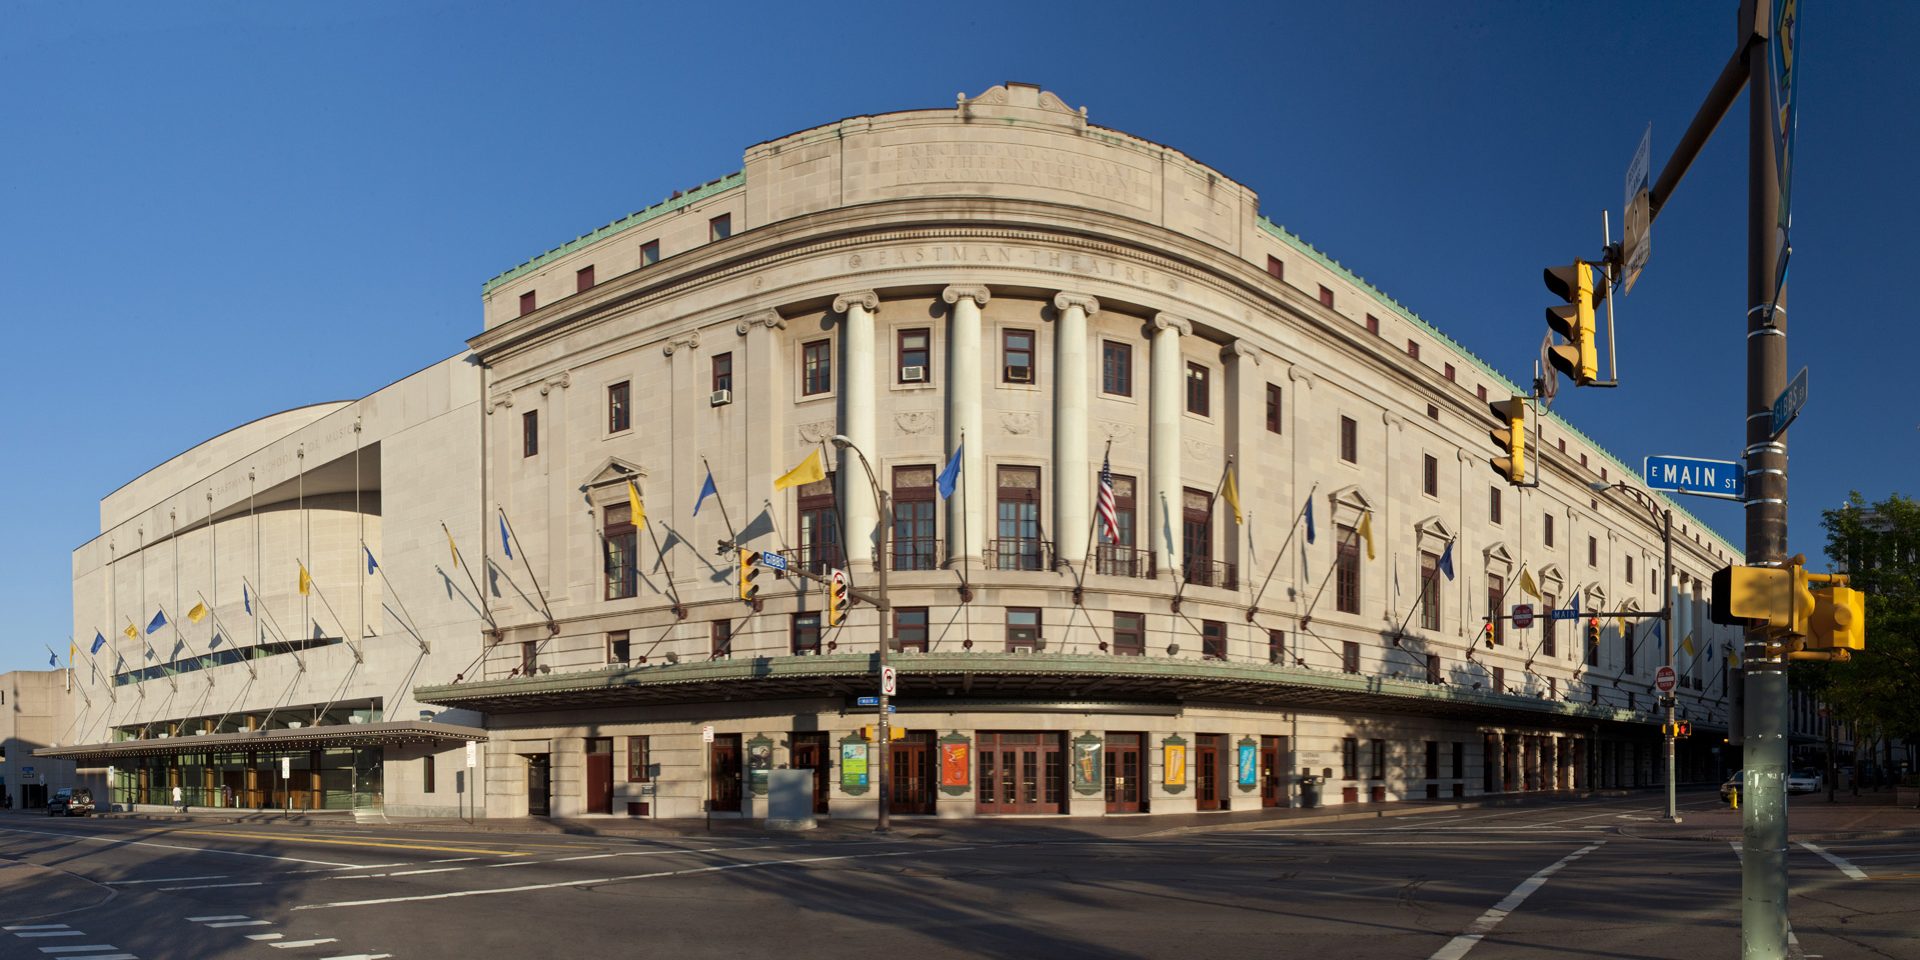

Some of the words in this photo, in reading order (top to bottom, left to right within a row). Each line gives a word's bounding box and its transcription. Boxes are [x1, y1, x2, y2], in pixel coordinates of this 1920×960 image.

[946, 156, 986, 169] THE
[878, 246, 1011, 266] EASTMAN
[1029, 249, 1151, 286] THEATRE
[1651, 466, 1658, 477] E
[1664, 463, 1716, 487] MAIN
[1724, 478, 1738, 489] ST
[765, 553, 785, 568] GIBBS
[1554, 610, 1576, 619] MAIN
